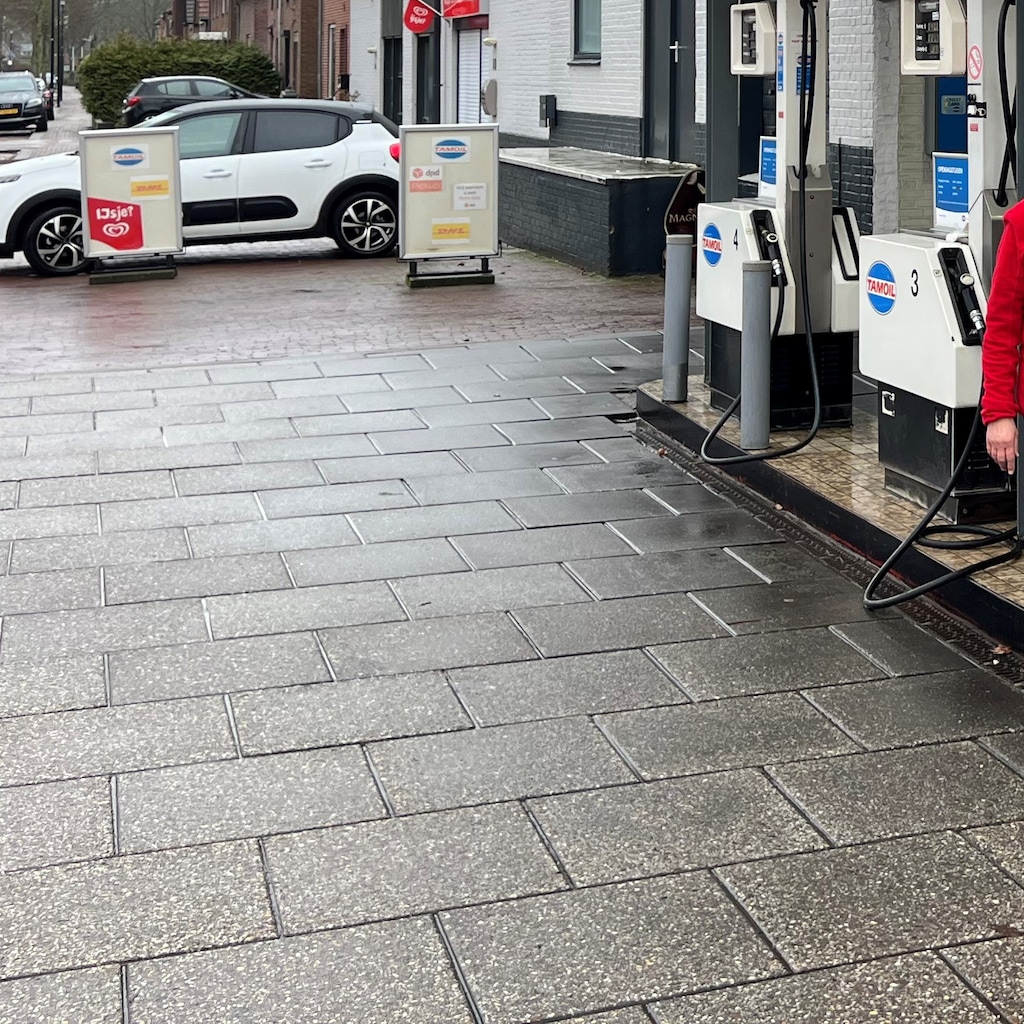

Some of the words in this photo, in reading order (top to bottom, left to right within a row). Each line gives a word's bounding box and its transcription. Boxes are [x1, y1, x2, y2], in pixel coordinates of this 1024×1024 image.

[425, 169, 440, 177] dpd
[702, 237, 722, 252] TAMOIL
[733, 228, 738, 250] 4
[866, 278, 896, 298] TAMOIL
[910, 269, 919, 297] 3
